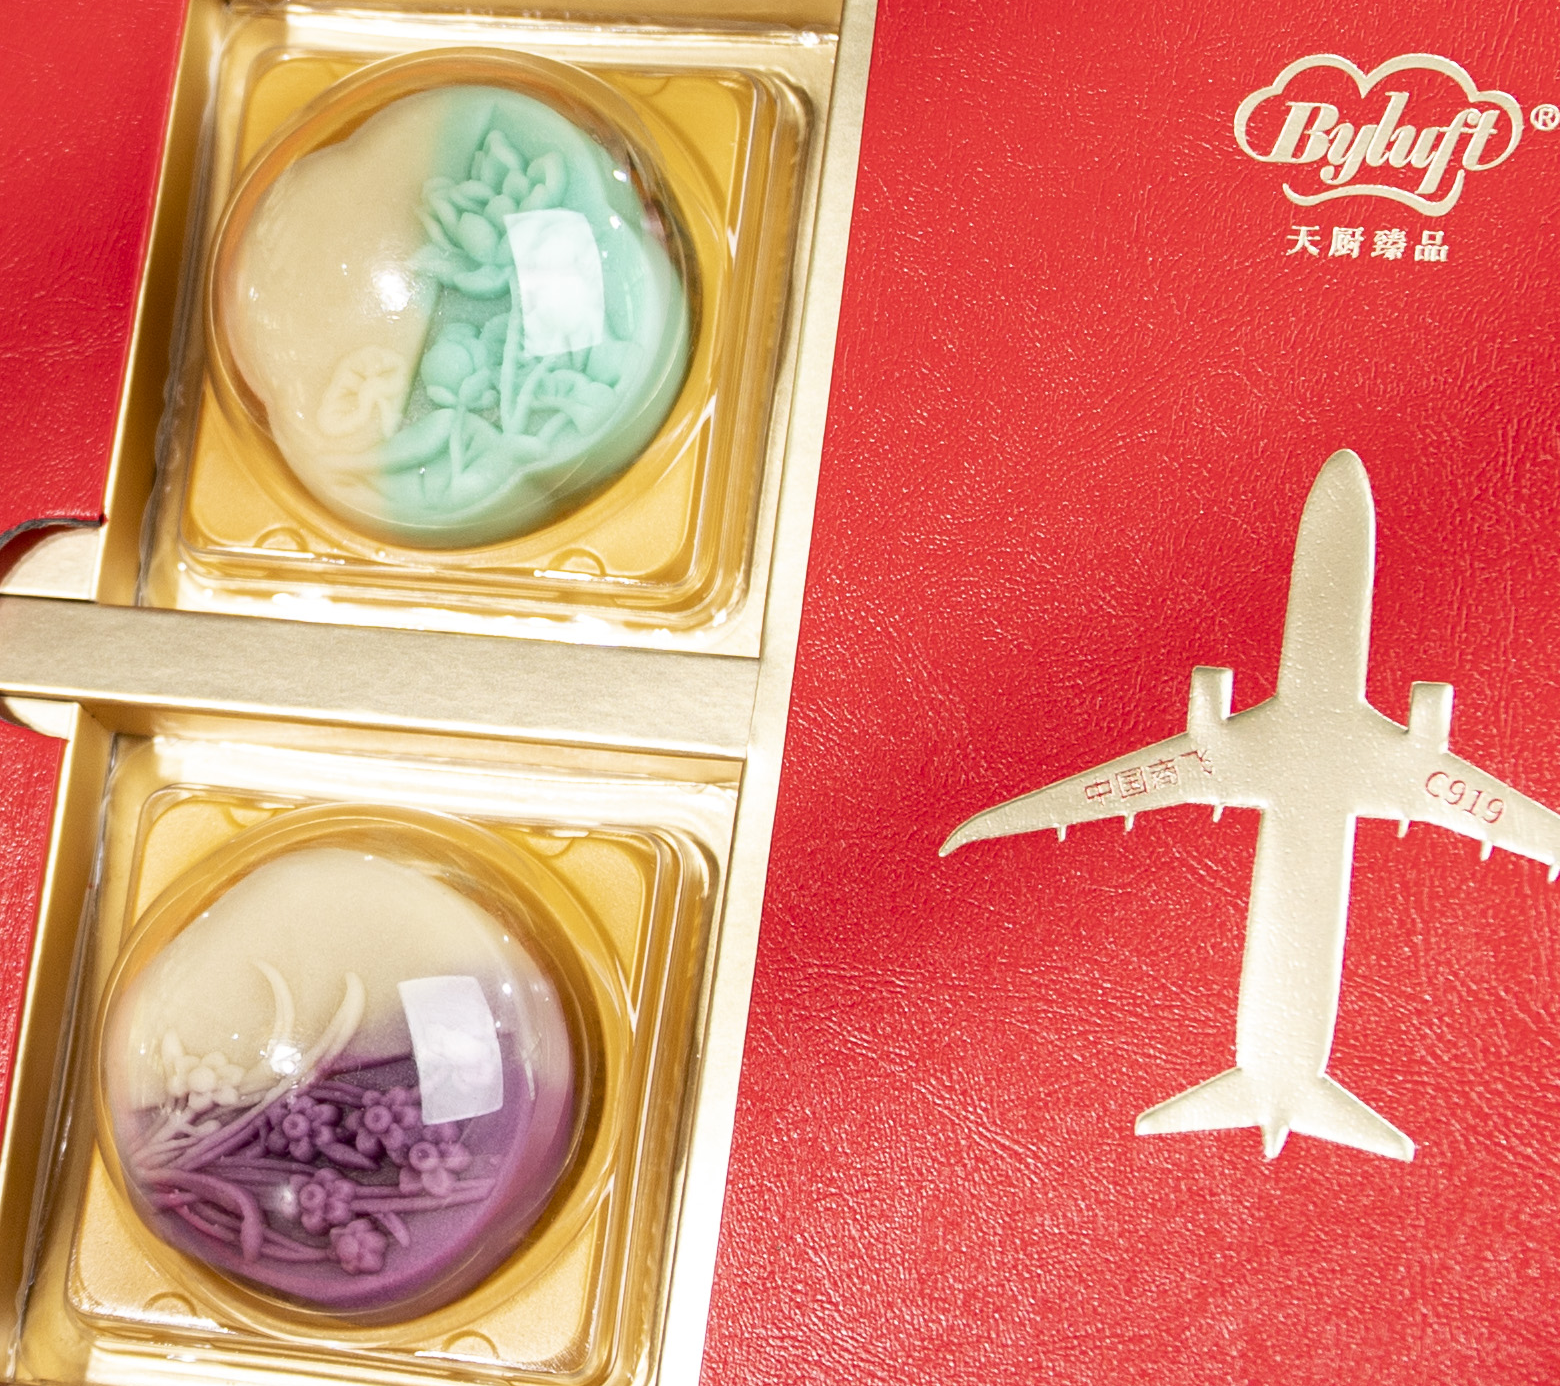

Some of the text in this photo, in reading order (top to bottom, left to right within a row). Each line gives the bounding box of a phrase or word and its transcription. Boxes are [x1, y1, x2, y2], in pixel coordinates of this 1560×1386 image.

[1271, 91, 1501, 196] Byluft
[1285, 225, 1449, 262] 天厨臻品
[1425, 771, 1504, 824] C919
